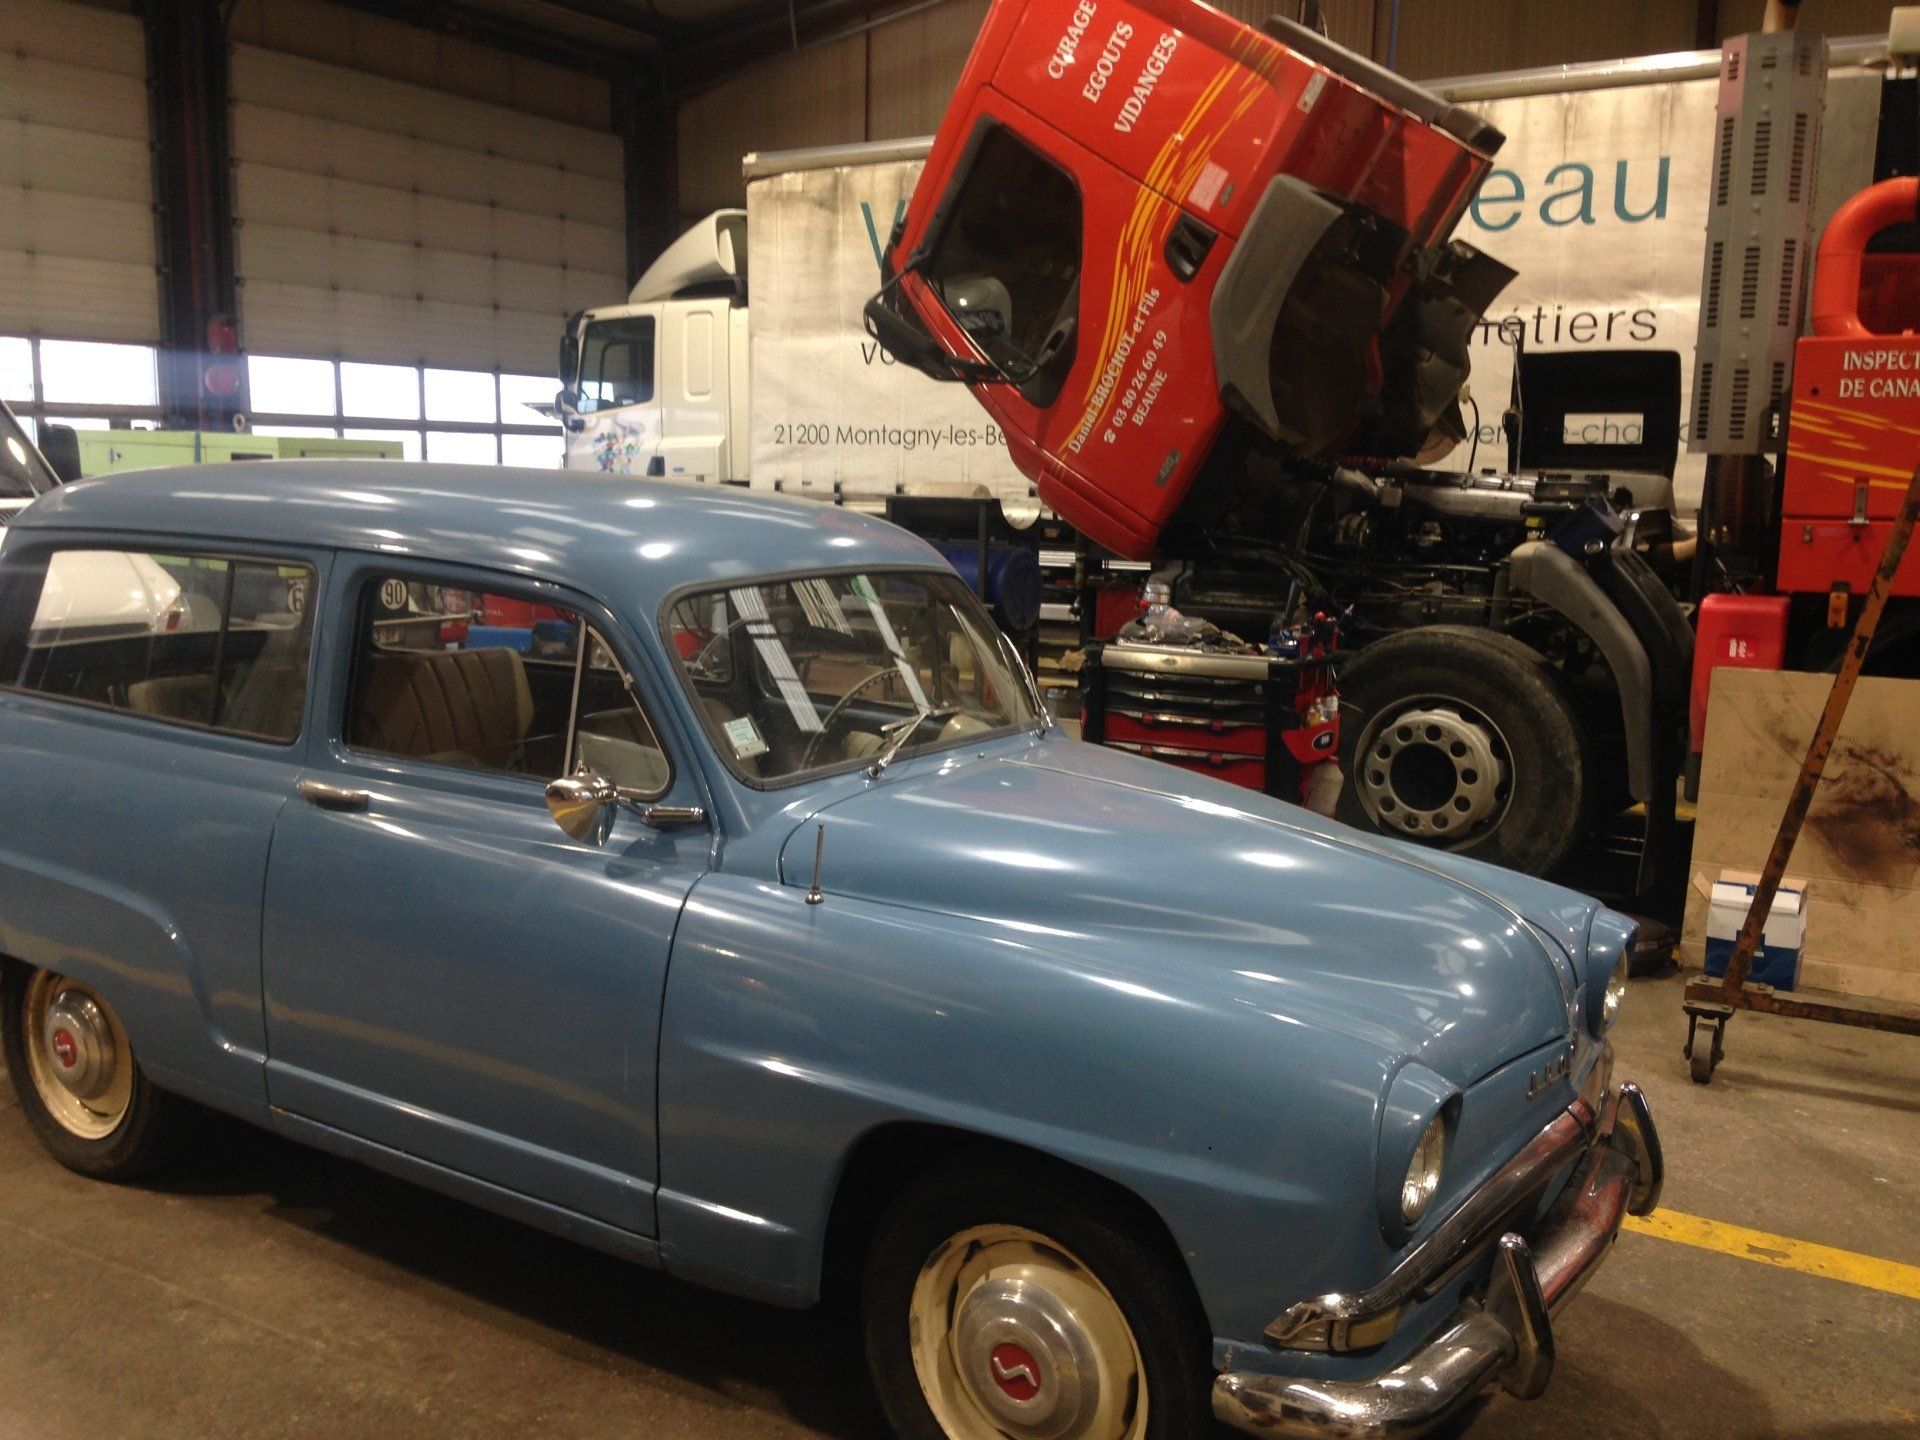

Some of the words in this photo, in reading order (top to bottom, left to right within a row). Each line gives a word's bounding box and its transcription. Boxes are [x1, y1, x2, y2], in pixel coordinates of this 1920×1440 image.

[1048, 0, 1097, 79] CURAGE
[1082, 21, 1133, 104] EGOUTS
[1113, 33, 1177, 133] VIDANGES
[1133, 315, 1145, 333] et
[1138, 287, 1160, 316] Fils
[1092, 332, 1135, 408] BROCHOT
[1112, 407, 1127, 428] 03
[1122, 388, 1137, 408] 80
[1132, 368, 1147, 390] 26
[1142, 350, 1157, 371] 60
[1152, 330, 1167, 350] 49
[1840, 378, 1865, 398] DE
[1132, 369, 1168, 427] BEAUNE
[774, 424, 829, 445] 21200
[1068, 405, 1098, 454] Daniel
[386, 582, 402, 606] 90
